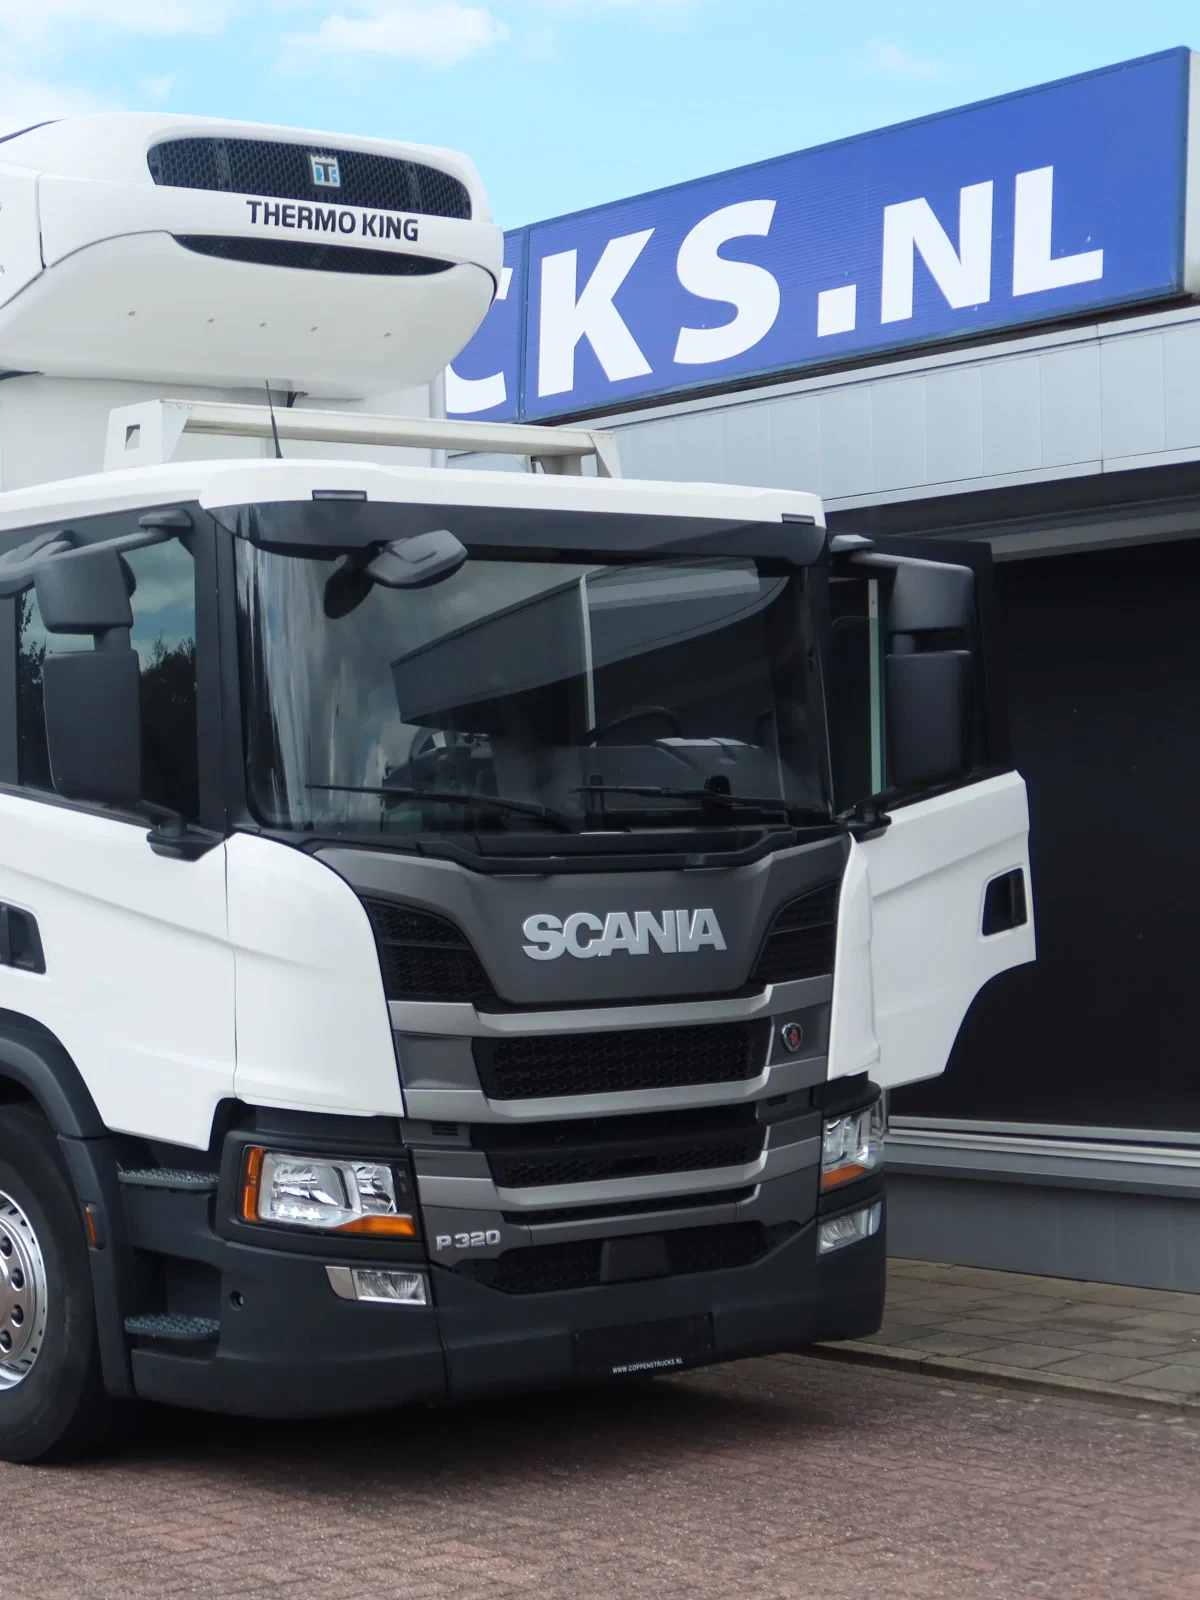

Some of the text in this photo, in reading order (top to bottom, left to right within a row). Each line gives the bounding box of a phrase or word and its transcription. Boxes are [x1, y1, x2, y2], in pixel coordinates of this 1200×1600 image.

[246, 200, 419, 242] THERMO KING
[522, 908, 727, 961] SCANIA
[435, 1229, 501, 1251] P 320
[612, 1358, 683, 1374] WWW.COPPENSTRUCKS.NL
